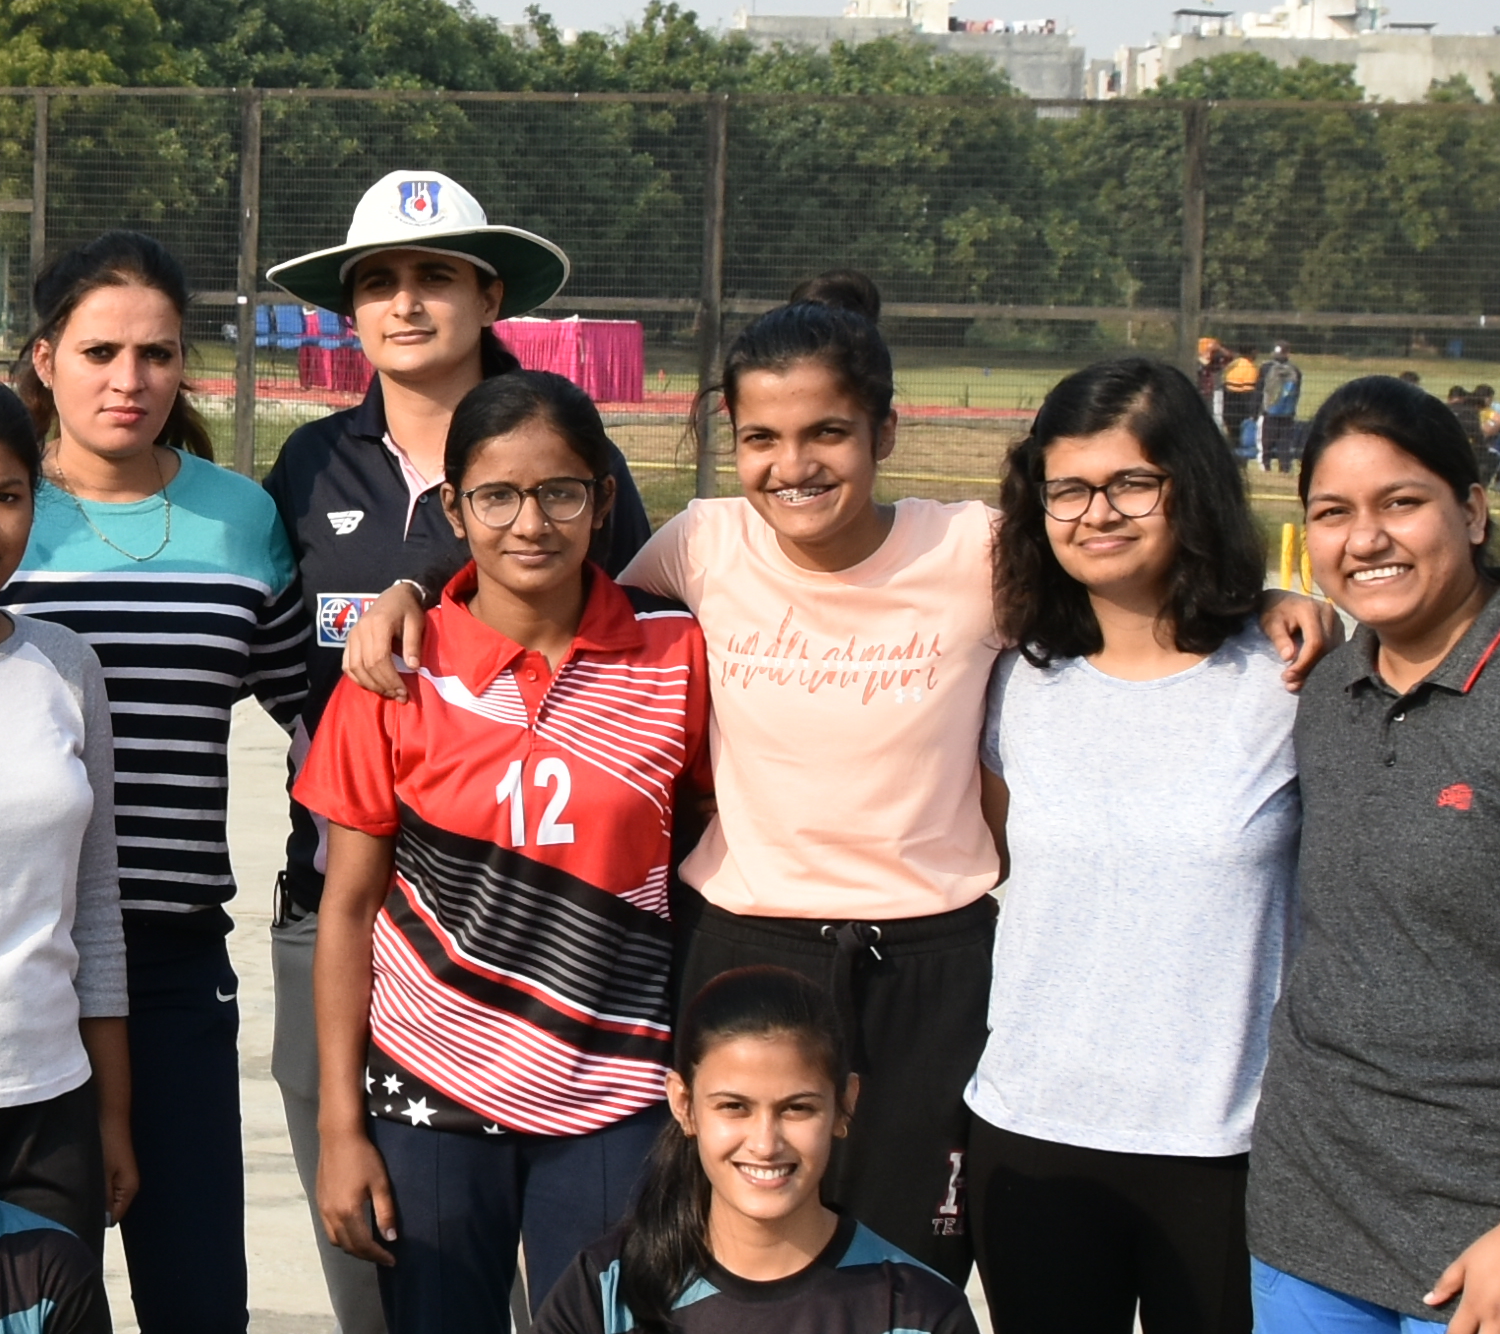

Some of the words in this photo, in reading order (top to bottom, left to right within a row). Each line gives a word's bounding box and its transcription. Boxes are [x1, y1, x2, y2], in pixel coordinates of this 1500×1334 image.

[748, 655, 810, 669] UNDER
[823, 659, 903, 670] ARMOUR
[495, 757, 575, 847] 12
